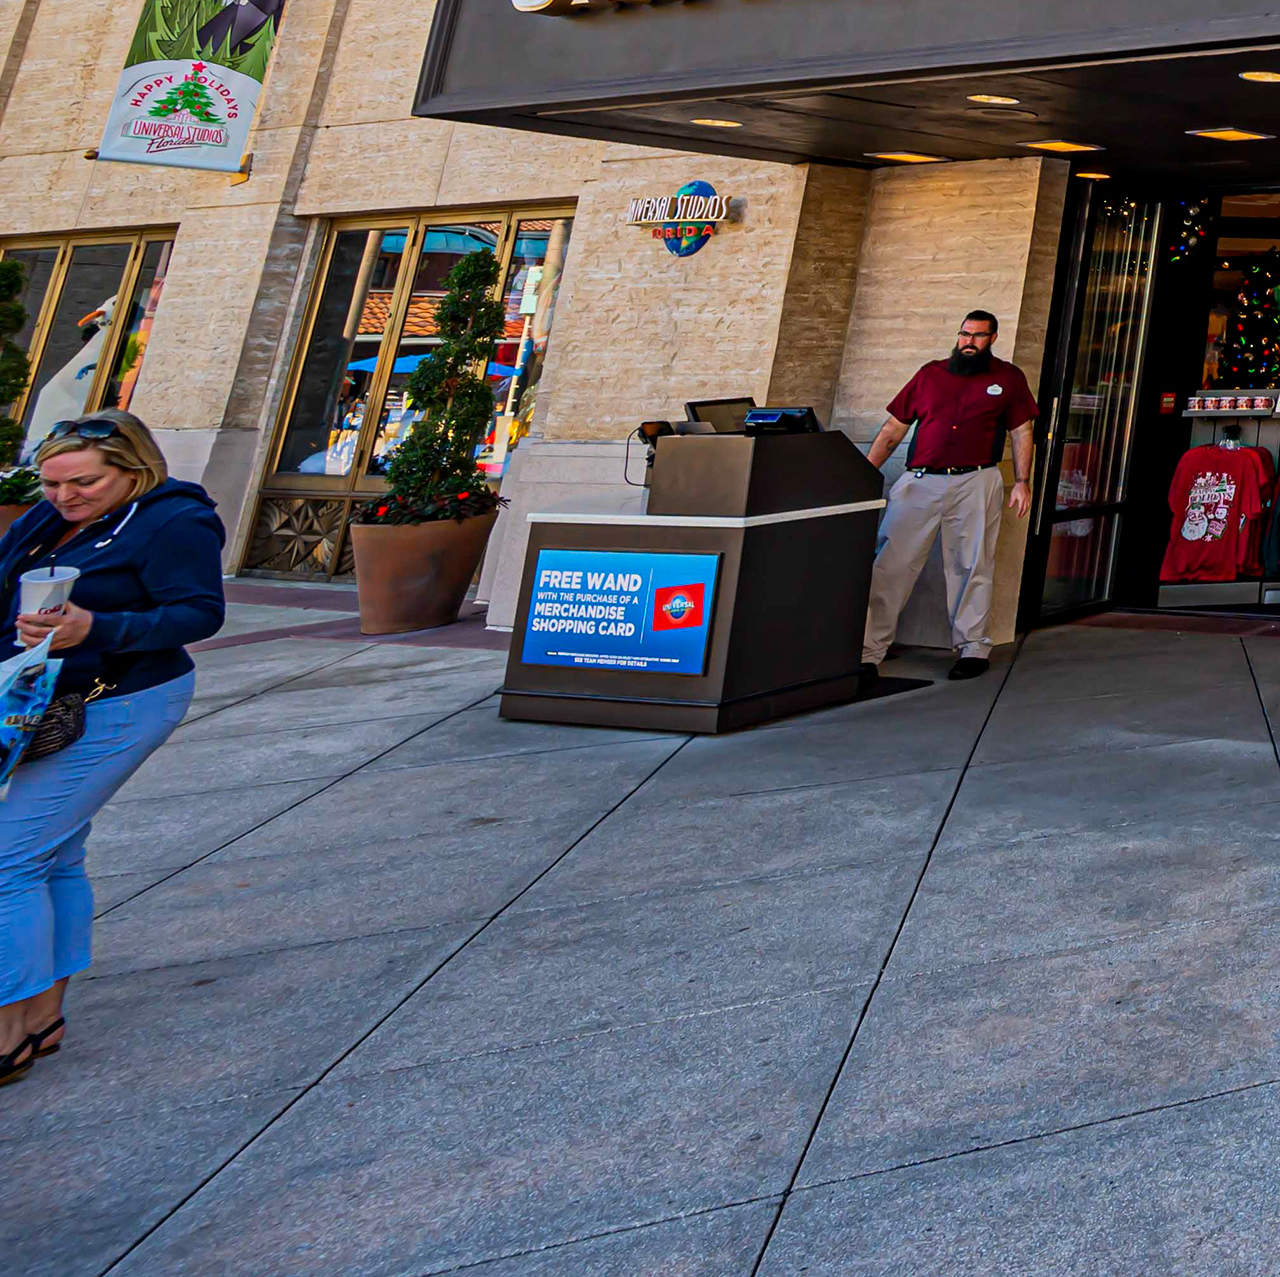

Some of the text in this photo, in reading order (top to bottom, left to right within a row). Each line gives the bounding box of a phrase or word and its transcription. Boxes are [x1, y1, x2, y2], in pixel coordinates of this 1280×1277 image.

[129, 74, 239, 119] HAPPY HOLIDAYS
[132, 120, 224, 144] UNIVERSAL STUDIOS
[146, 137, 200, 153] Florida
[673, 193, 732, 220] STUDIOS
[539, 569, 642, 592] FREE WAND
[537, 591, 639, 605] WITH THE PURCHASE OF A
[534, 602, 625, 620] MERCHANDISE
[531, 618, 635, 637] SHOPPING CARD
[627, 659, 648, 667] DETAILS
